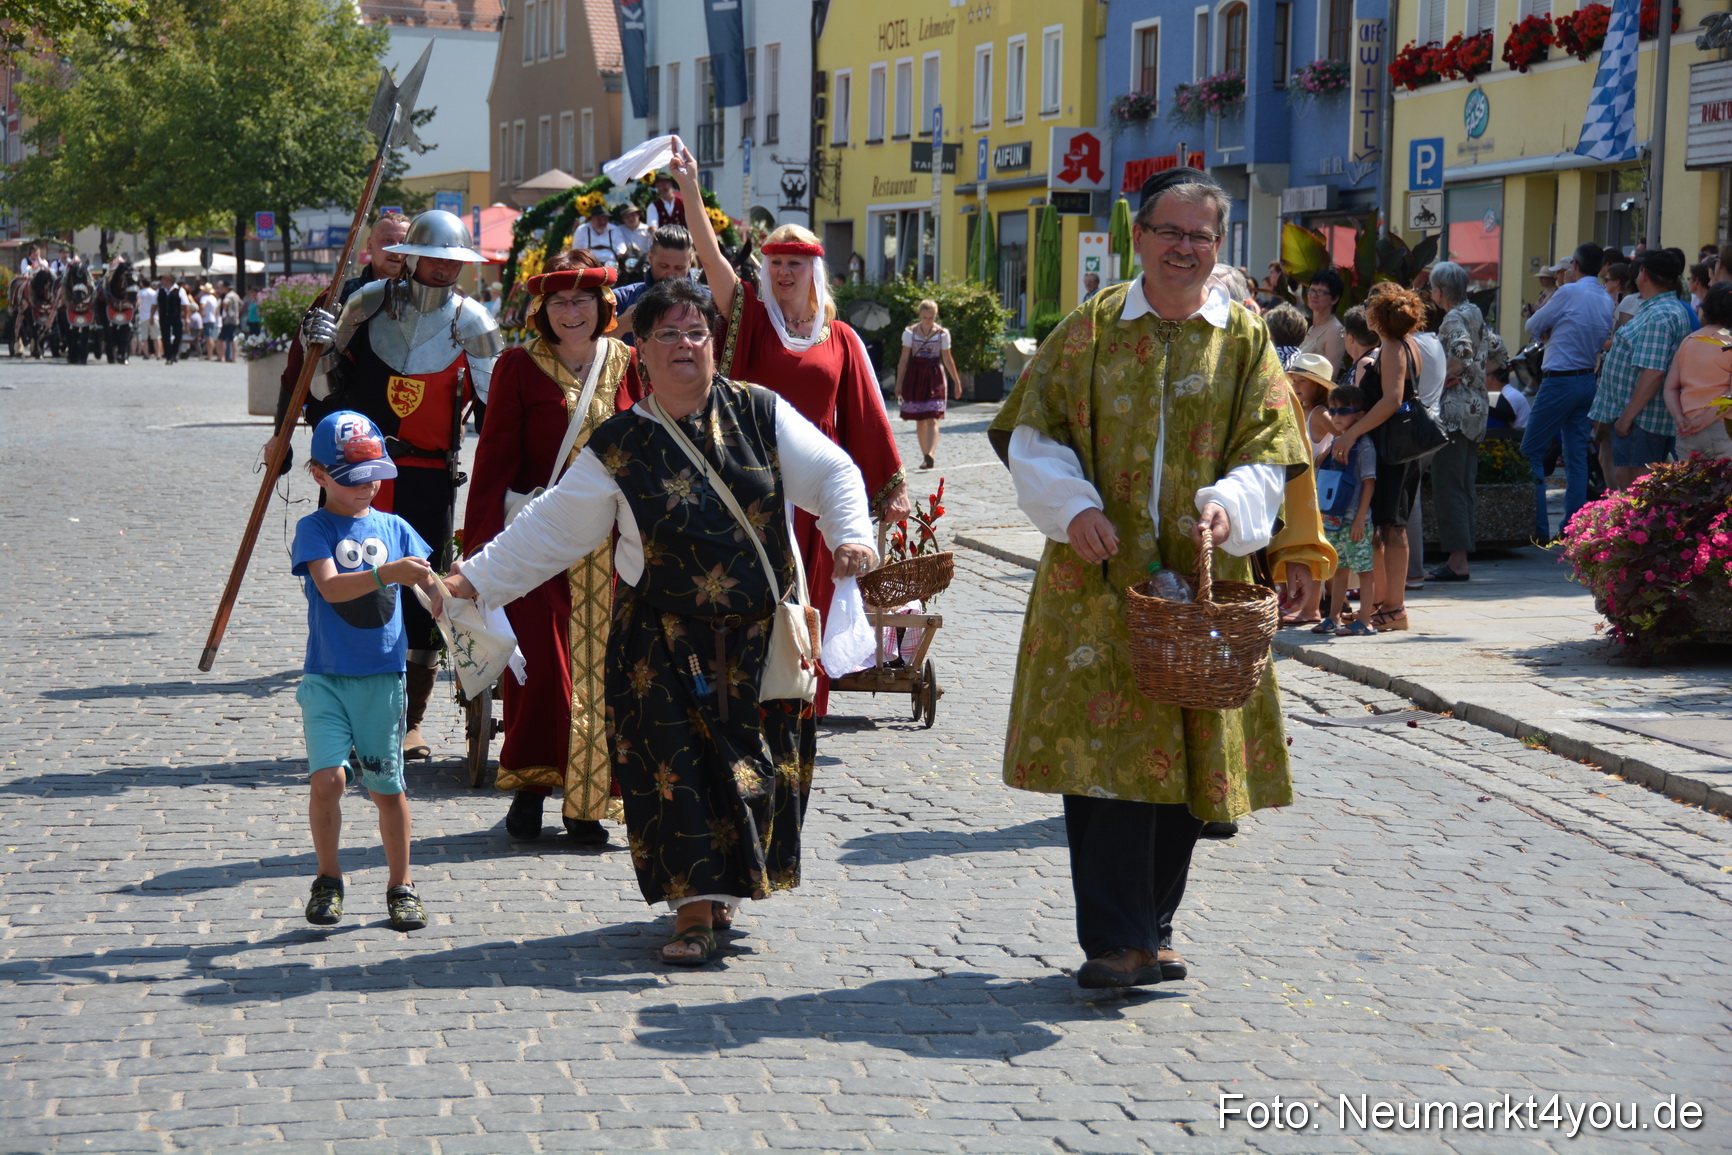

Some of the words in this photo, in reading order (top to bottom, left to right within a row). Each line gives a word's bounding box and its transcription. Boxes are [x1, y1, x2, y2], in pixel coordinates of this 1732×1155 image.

[878, 18, 910, 52] HOTEL
[913, 160, 954, 170] TAIUN
[992, 145, 1024, 168] TAIFUN
[1416, 145, 1436, 185] P
[872, 175, 917, 198] Restaurant
